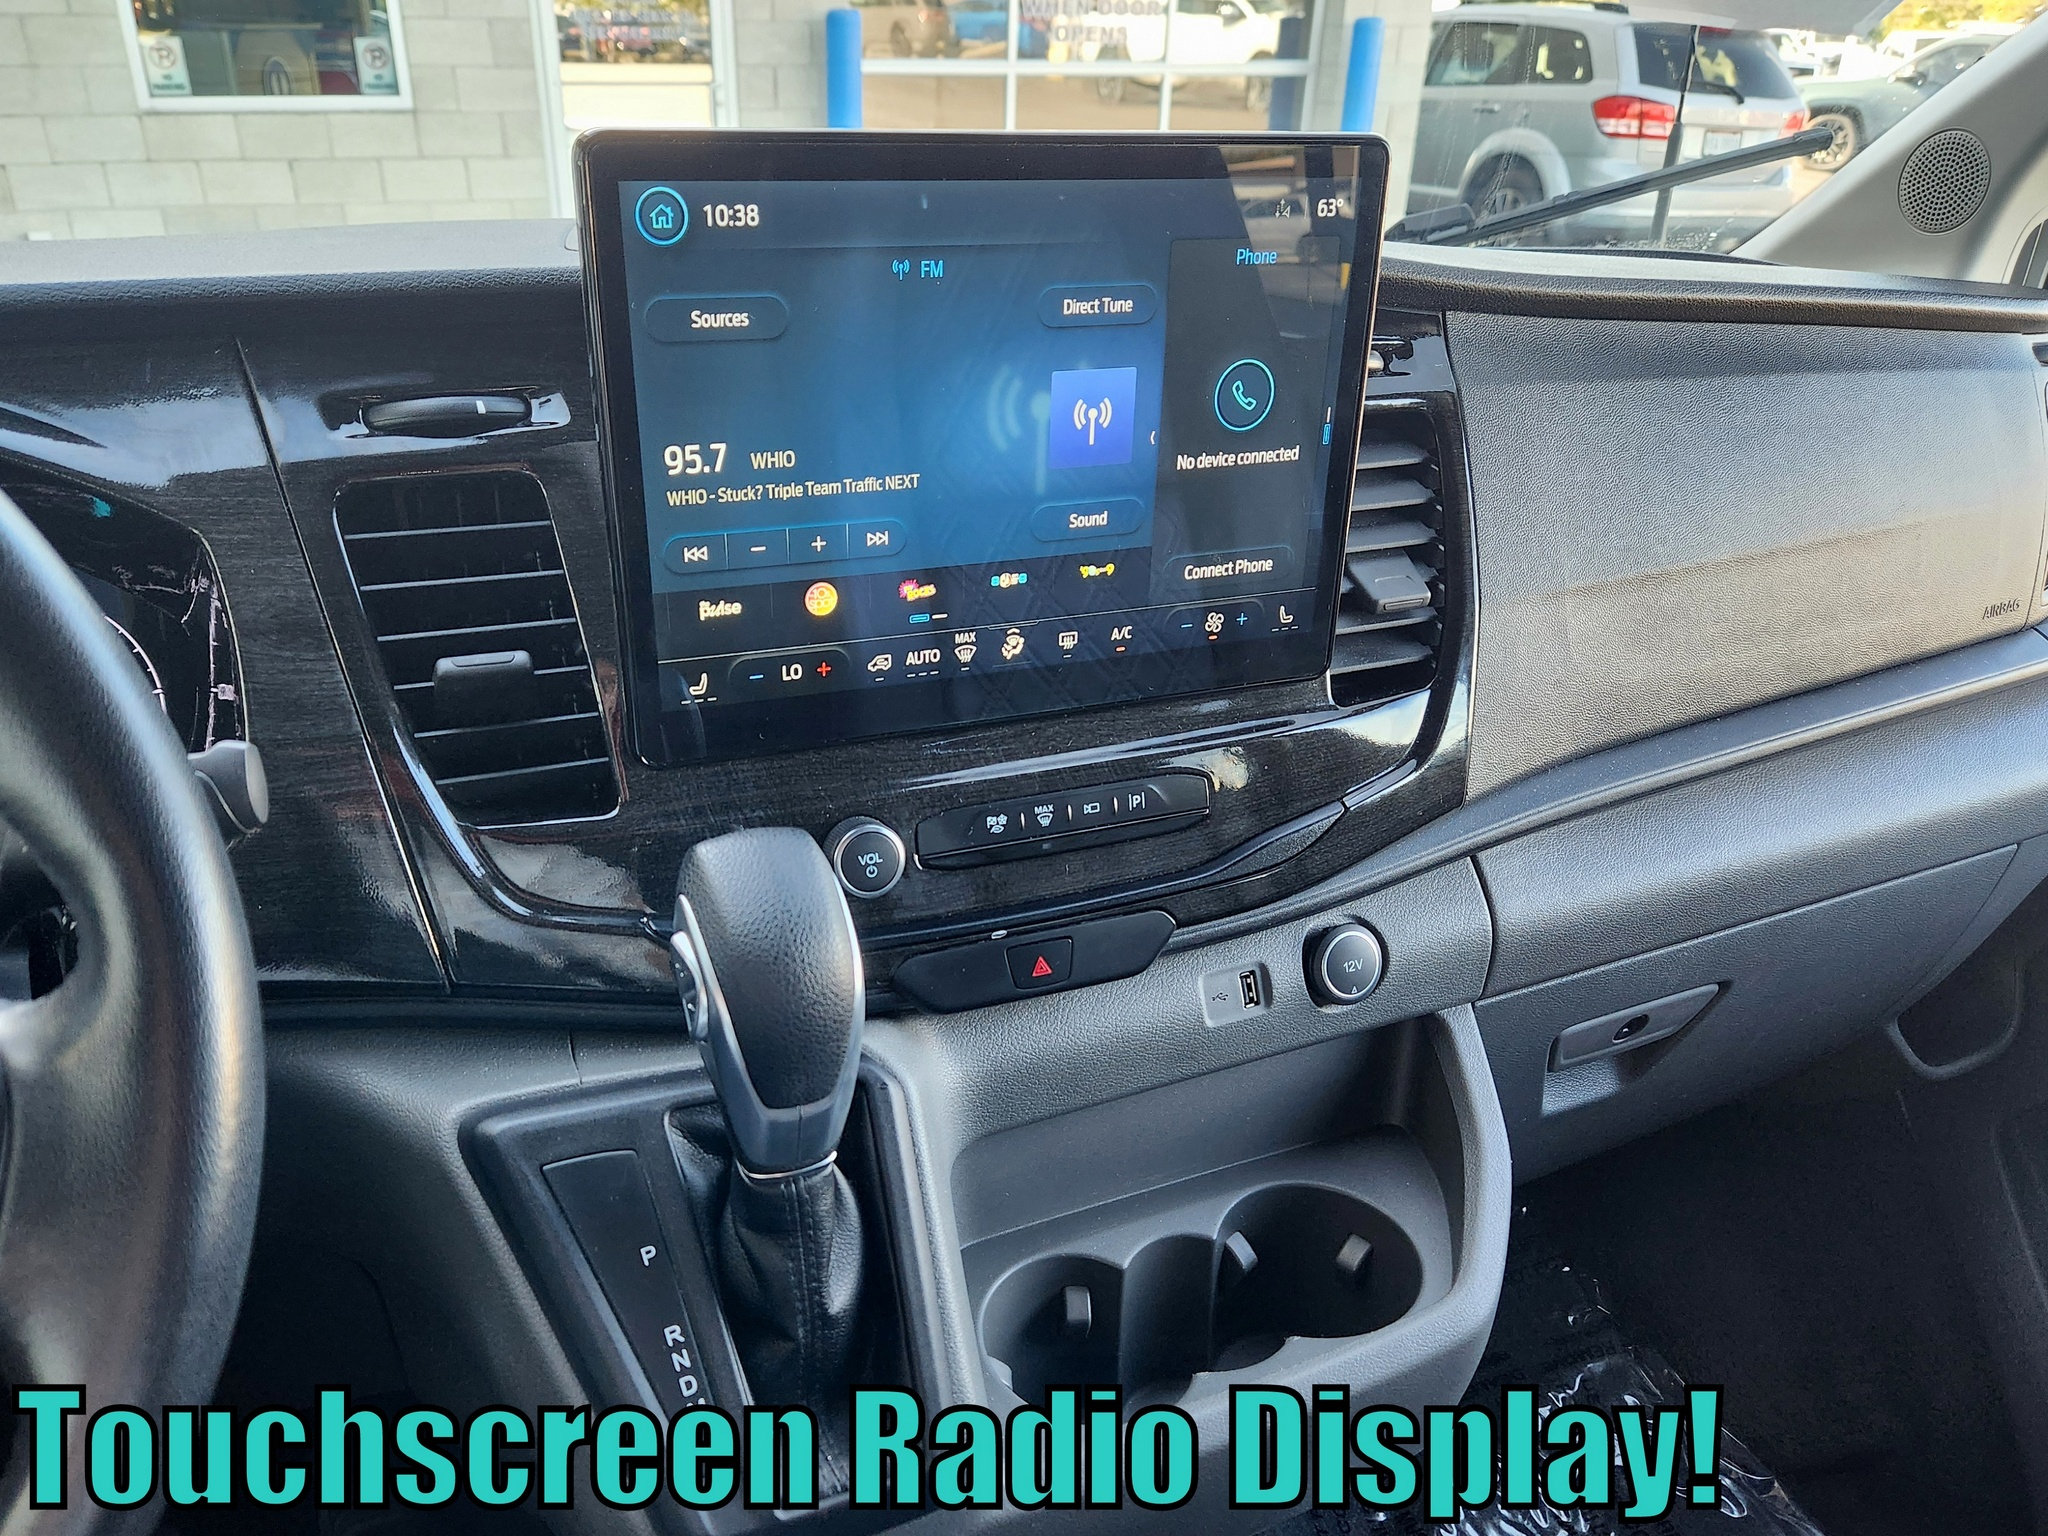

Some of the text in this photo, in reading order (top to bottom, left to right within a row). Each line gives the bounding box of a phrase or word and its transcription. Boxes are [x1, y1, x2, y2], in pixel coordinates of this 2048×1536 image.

[703, 203, 760, 228] 10:38
[1317, 197, 1344, 218] 63°
[1236, 247, 1278, 266] Phone
[920, 260, 944, 279] FM
[1063, 296, 1133, 316] Direct Tune
[690, 309, 750, 330] Sources
[663, 442, 728, 476] 95.7
[750, 450, 796, 470] WHIO
[1176, 445, 1301, 471] No device connected
[667, 487, 707, 507] WHIO
[717, 482, 764, 504] Stuck?
[766, 482, 804, 500] Triple
[805, 480, 841, 498] Team
[843, 476, 884, 494] Traffic
[885, 473, 920, 491] NEXT
[1068, 510, 1109, 529] Sound
[1184, 557, 1274, 581] Connect Phone
[1982, 598, 2021, 620] AIRBAG
[955, 632, 976, 645] MAX
[1110, 626, 1133, 641] A/C
[905, 649, 941, 666] AUTO
[781, 664, 803, 682] LO
[1034, 804, 1054, 815] MAX
[857, 852, 884, 868] VOL
[1342, 959, 1364, 975] 12V
[640, 1245, 657, 1267] P
[664, 1324, 686, 1348] R
[671, 1348, 692, 1373] N
[678, 1374, 699, 1398] D
